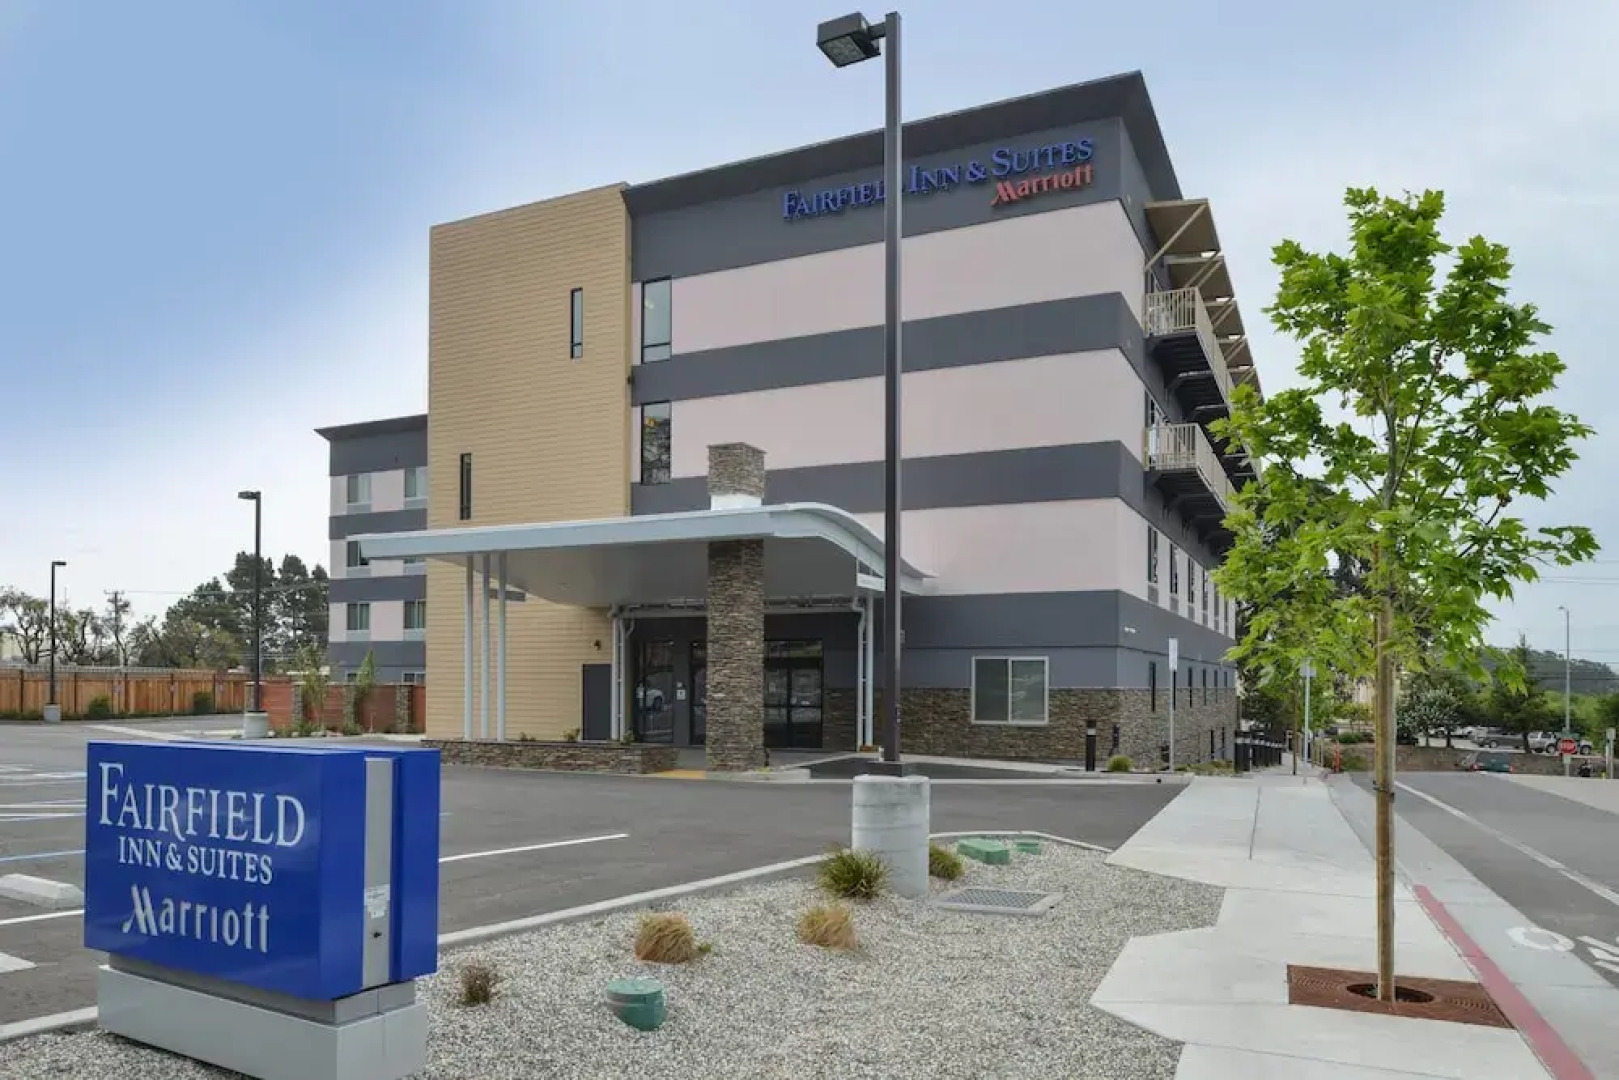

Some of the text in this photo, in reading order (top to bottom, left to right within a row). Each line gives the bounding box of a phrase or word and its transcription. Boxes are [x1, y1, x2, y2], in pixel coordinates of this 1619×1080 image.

[782, 138, 1094, 219] FAIRFIEL INN & SUITES
[991, 163, 1093, 205] Marriott
[99, 762, 306, 847] FAIRFIELD
[119, 836, 273, 885] INN & SUITES
[122, 884, 270, 953] Marriott
